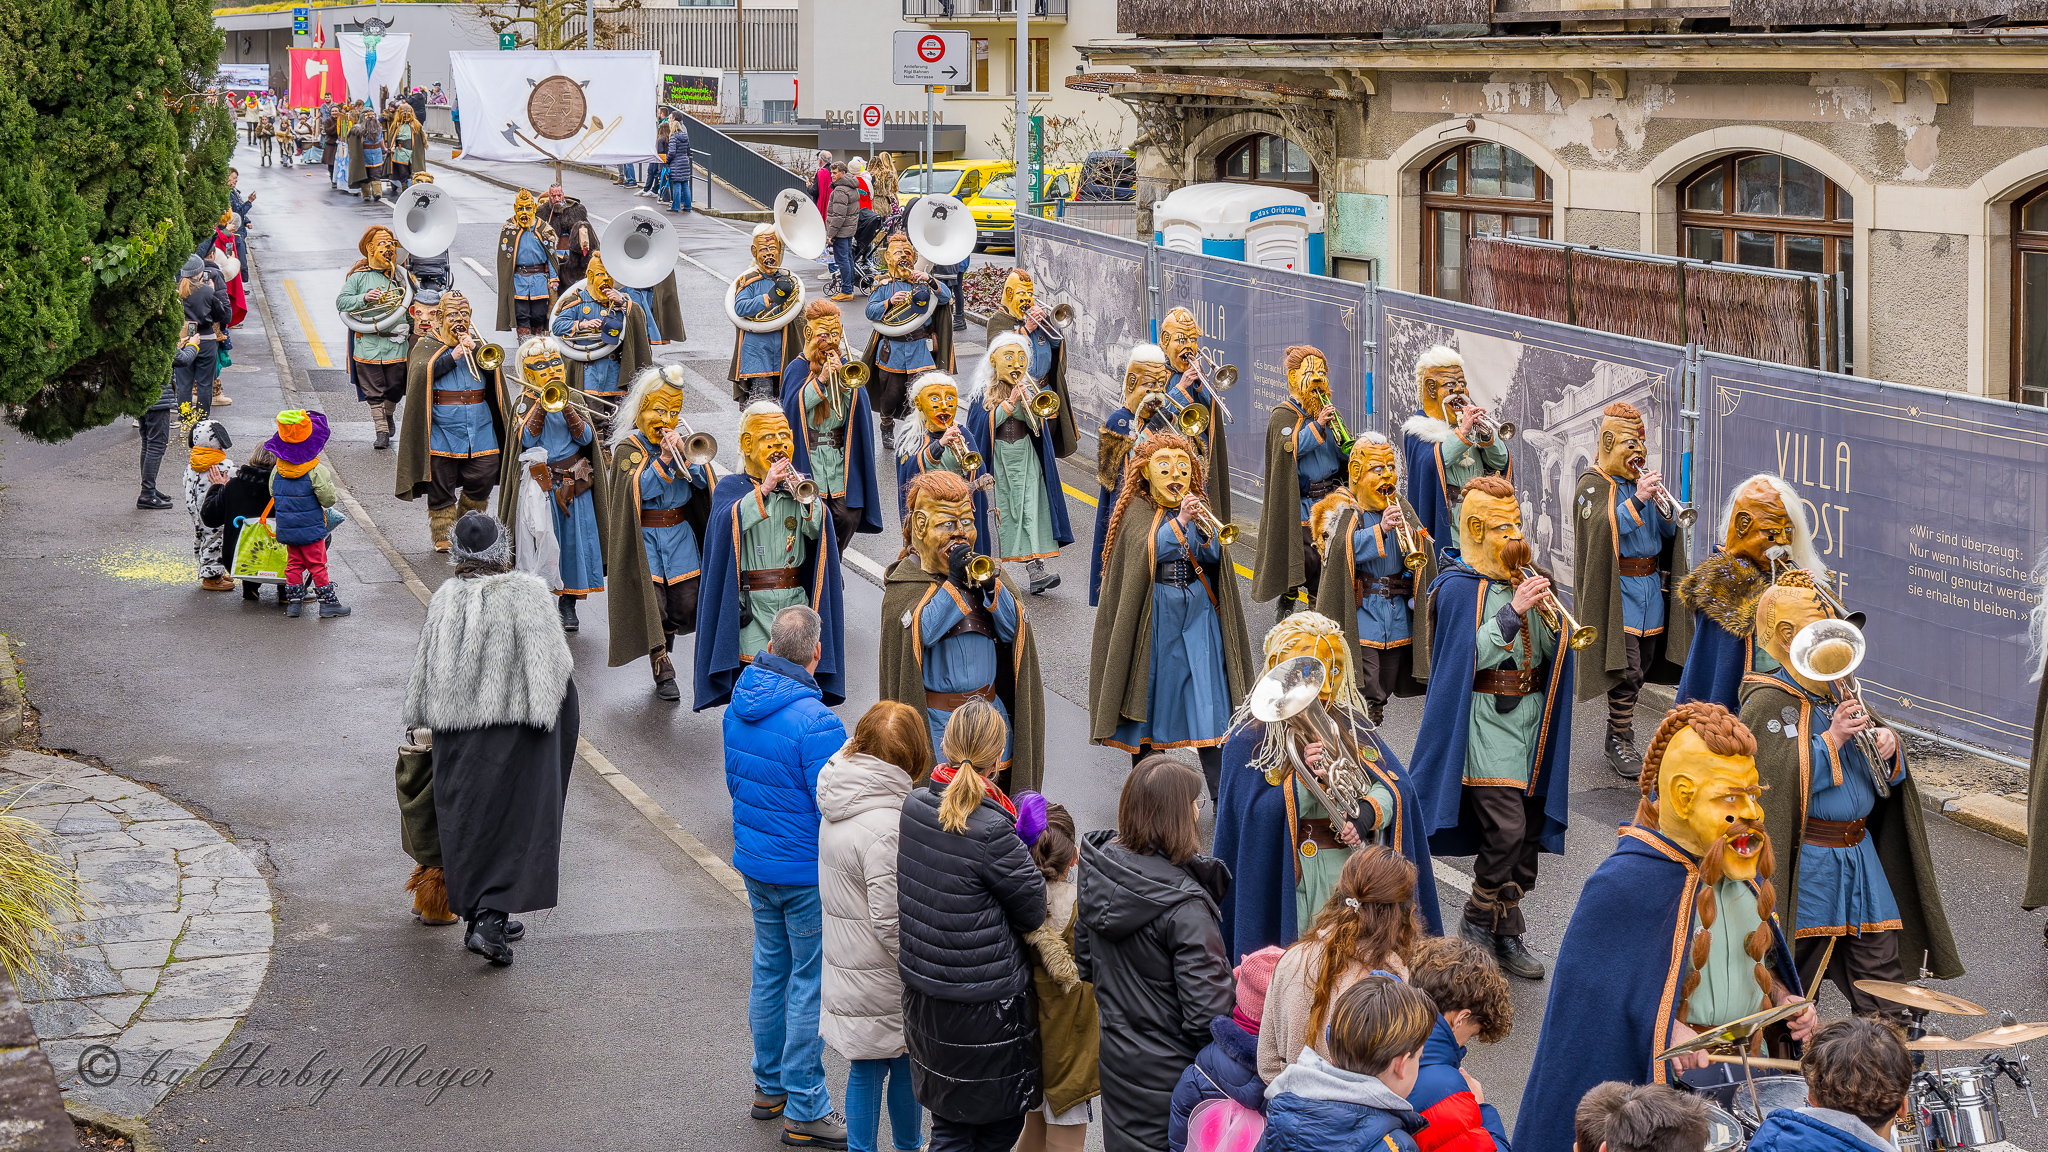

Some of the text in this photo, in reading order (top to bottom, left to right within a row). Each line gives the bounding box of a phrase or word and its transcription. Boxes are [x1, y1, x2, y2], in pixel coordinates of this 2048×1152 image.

[544, 93, 573, 117] 25
[825, 110, 943, 123] RIGI AHNEN
[1193, 299, 1226, 341] VILLA
[1264, 361, 1282, 375] braucht
[1254, 386, 1260, 395] im
[1262, 387, 1275, 399] Heute
[1276, 393, 1285, 401] und
[1254, 400, 1264, 411] das,
[1776, 430, 1850, 494] VILLA
[1800, 498, 1849, 558] OST
[1909, 524, 2024, 562] «Wir sind überzeugt:
[1909, 542, 1929, 559] Nur
[1931, 550, 1959, 567] wenn
[1963, 555, 2027, 582] historische
[1908, 563, 2041, 604] sinnvoll genutzt werden
[1908, 582, 2029, 621] sie erhalten bleiben.»
